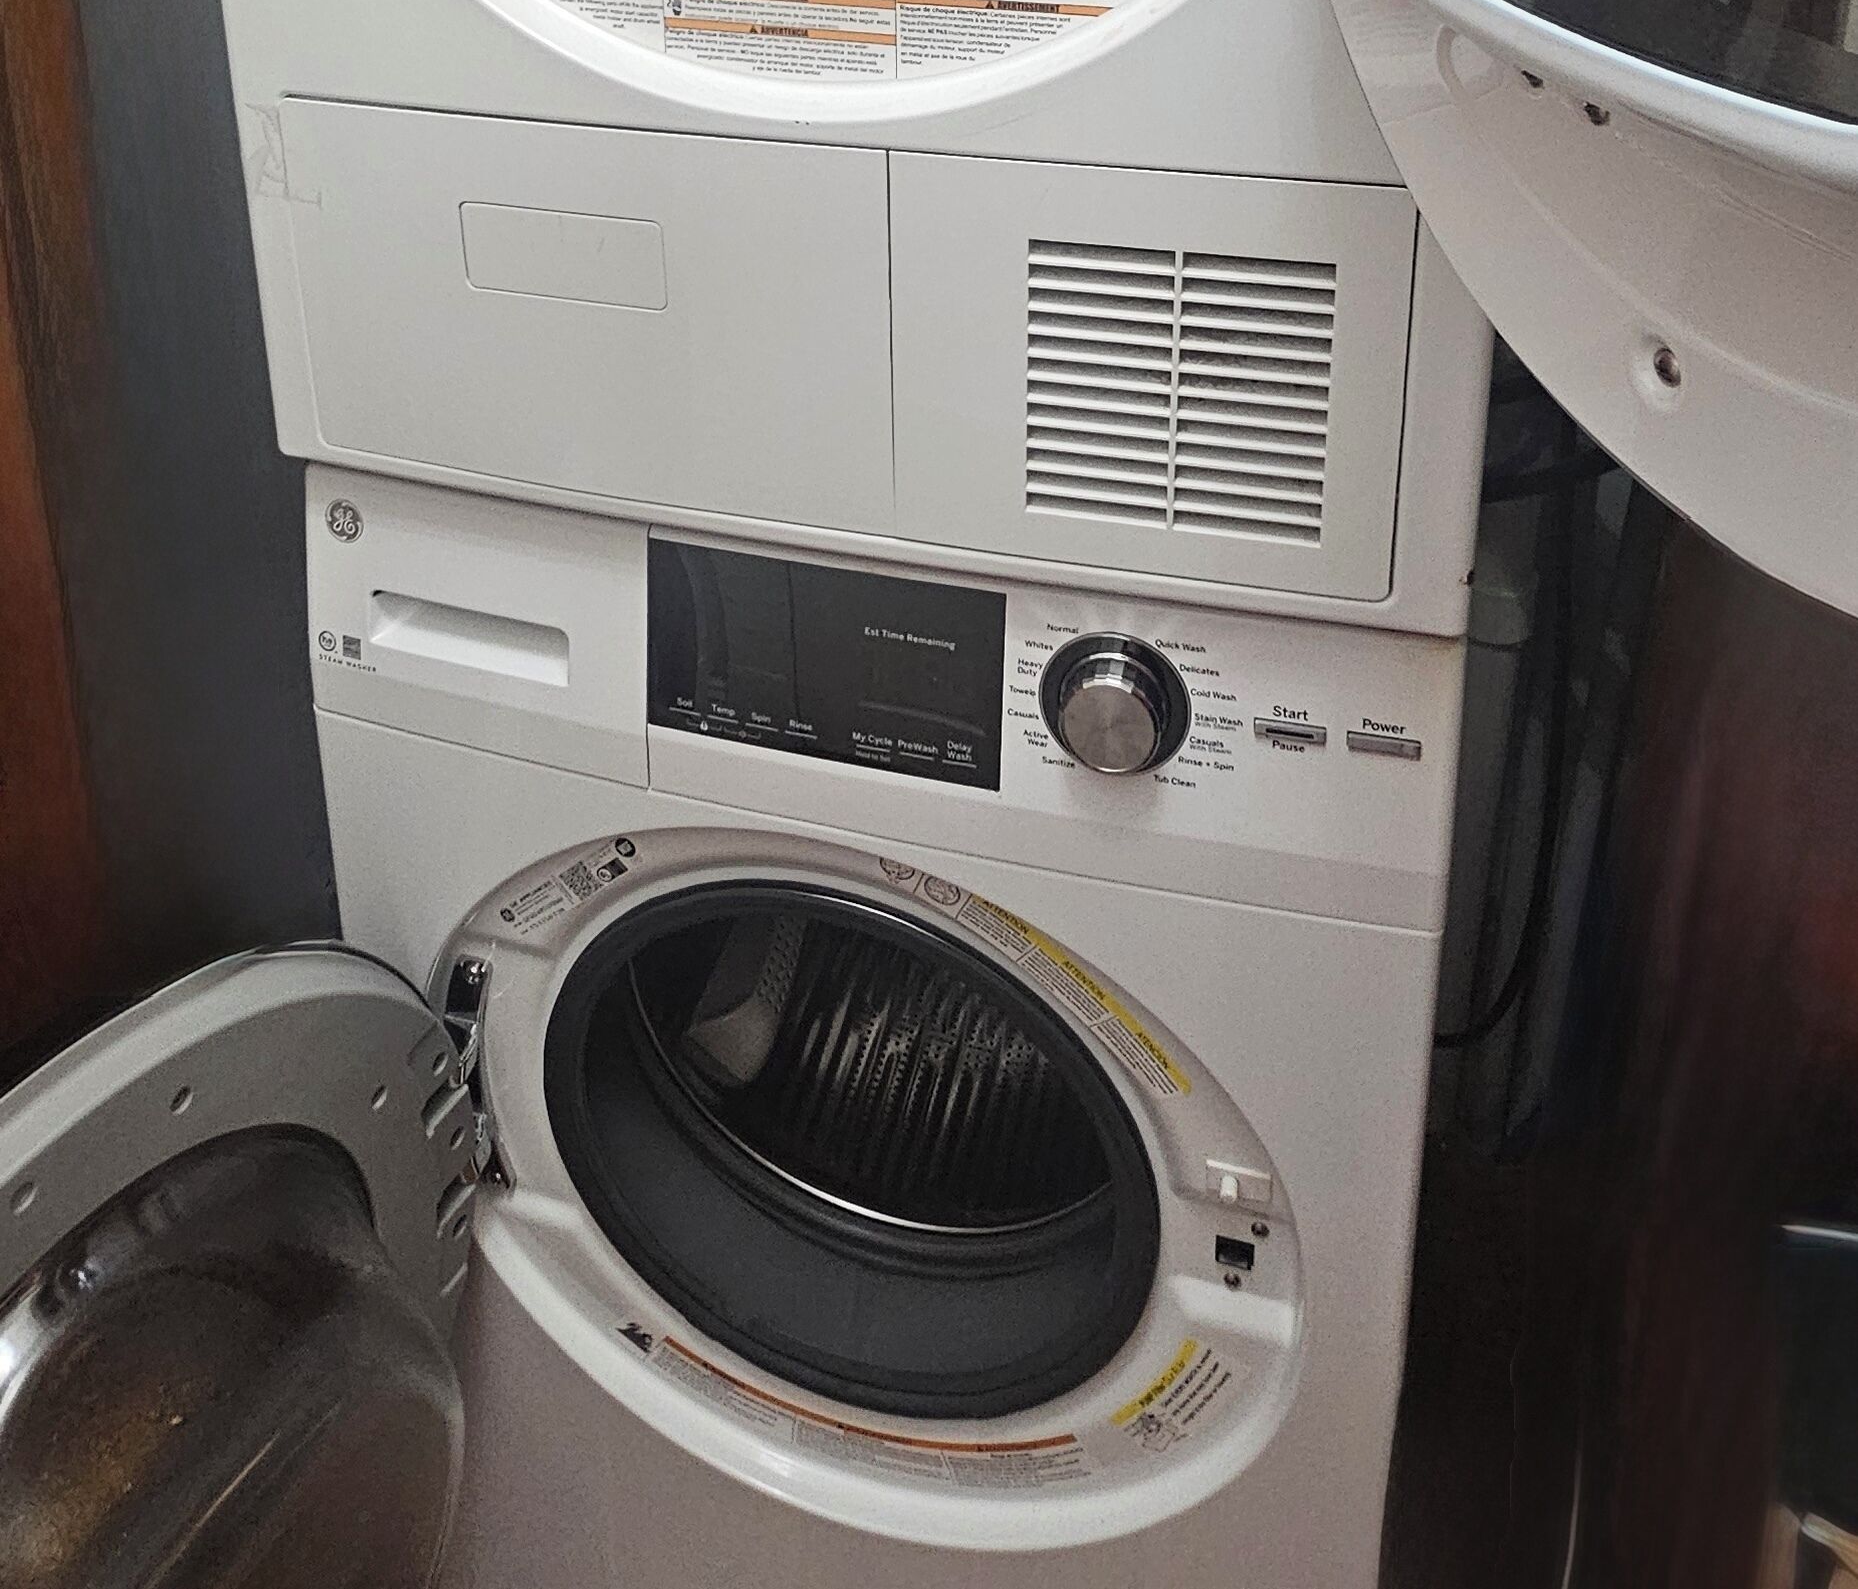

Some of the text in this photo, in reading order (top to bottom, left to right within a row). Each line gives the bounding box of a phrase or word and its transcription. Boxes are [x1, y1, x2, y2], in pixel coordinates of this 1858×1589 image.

[1047, 623, 1079, 634] Normal
[864, 626, 956, 651] Est Time Remaining
[1025, 640, 1053, 651] Whites
[1155, 639, 1206, 653] Quick Wash
[1018, 658, 1043, 669] Heavy
[1018, 667, 1037, 677] Duty
[1180, 664, 1220, 677] Delicates
[1009, 685, 1036, 696] Towels
[1190, 688, 1237, 701] Cold Wash
[677, 697, 693, 708] Soil
[711, 704, 736, 716] Temp
[1007, 708, 1039, 720] Casuals
[1273, 705, 1308, 721] Start
[751, 712, 771, 723] Spin
[1194, 712, 1244, 727] Stain Wash
[789, 719, 813, 731] Rinse
[1362, 717, 1406, 734] Power
[852, 731, 892, 746] My Cycle
[1023, 729, 1048, 740] Active
[897, 739, 938, 753] PreWash
[947, 740, 972, 753] Delay
[1027, 739, 1048, 748] Wear
[1189, 736, 1224, 748] Casuals
[1272, 740, 1305, 753] Pause
[947, 751, 972, 761] Wash
[1042, 756, 1076, 768] Sanitize
[1178, 756, 1203, 767] Rinse
[1213, 761, 1234, 771] Spin
[1154, 774, 1197, 788] Tub Clean
